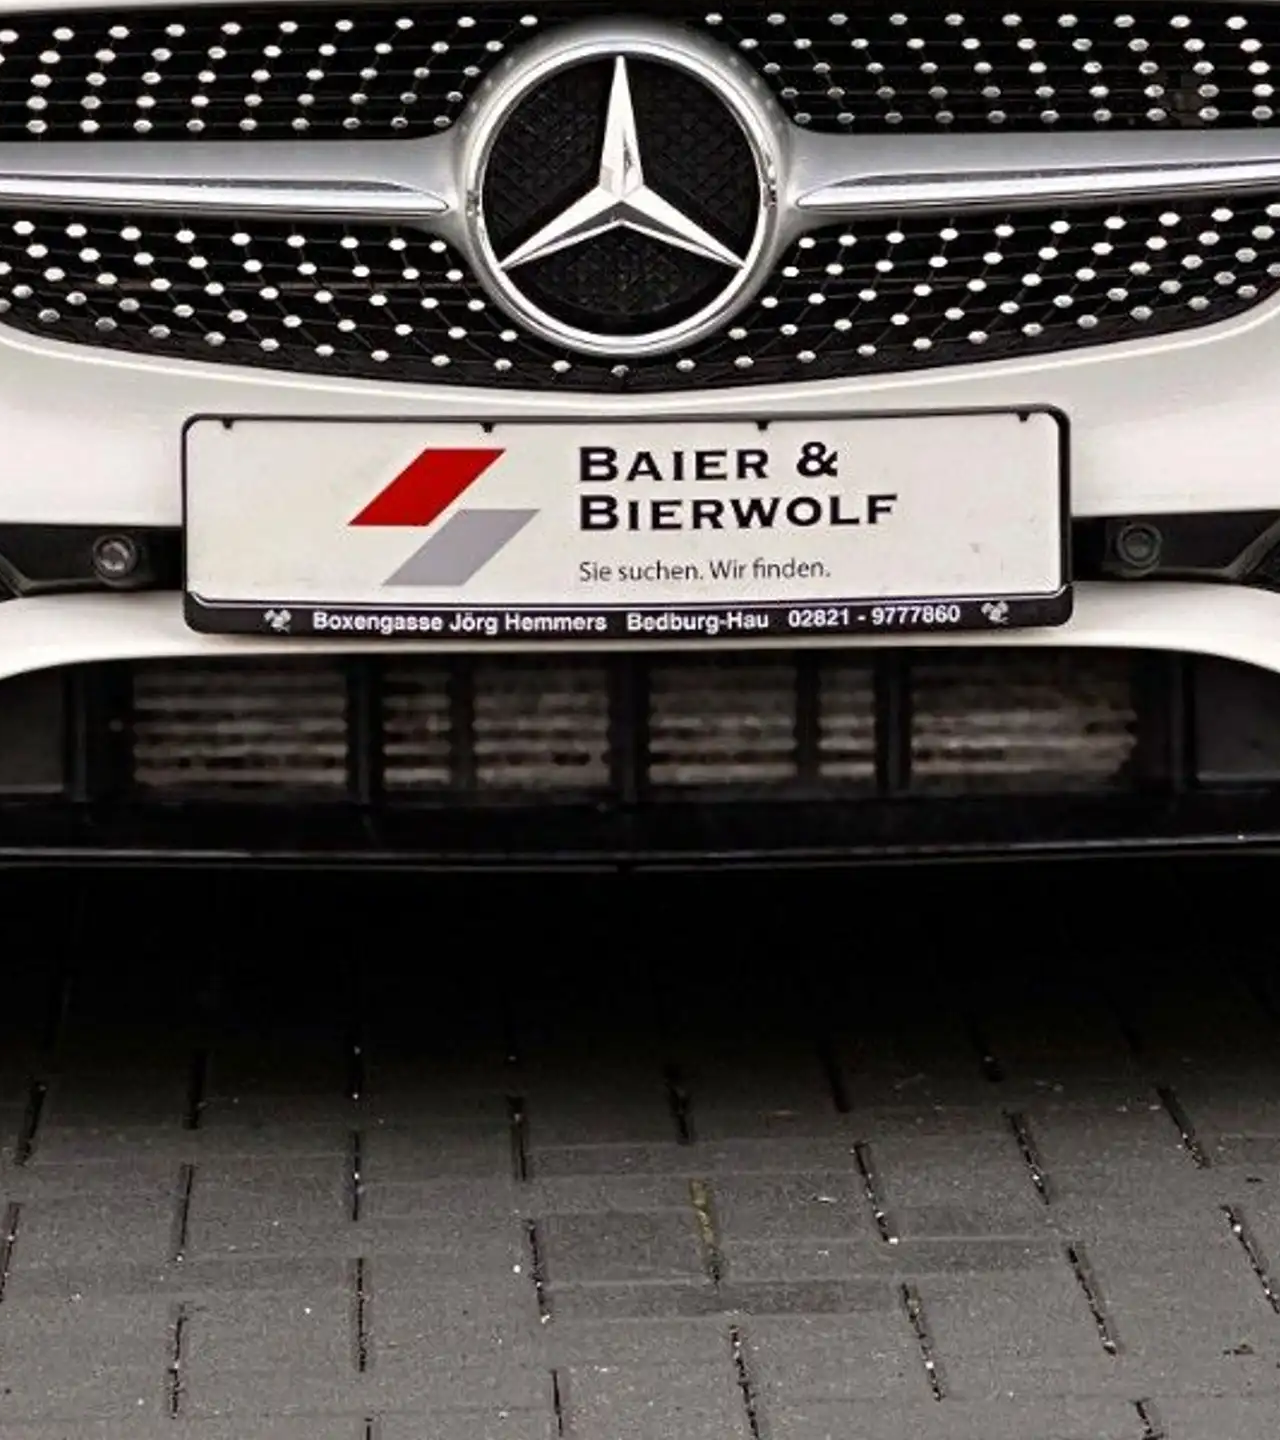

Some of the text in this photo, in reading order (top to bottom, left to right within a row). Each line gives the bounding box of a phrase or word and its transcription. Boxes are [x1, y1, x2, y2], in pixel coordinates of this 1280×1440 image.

[579, 441, 839, 482] BAIER &
[579, 493, 898, 532] BIERWOLF
[579, 557, 830, 582] Sie suchen. Wir finden.
[312, 611, 443, 635] Boxengasse
[449, 613, 499, 636] Jörg
[504, 613, 608, 632] Hemmers
[626, 611, 769, 635] Bedburg-Hau
[787, 608, 850, 628] 02821
[871, 604, 961, 626] 9777860
